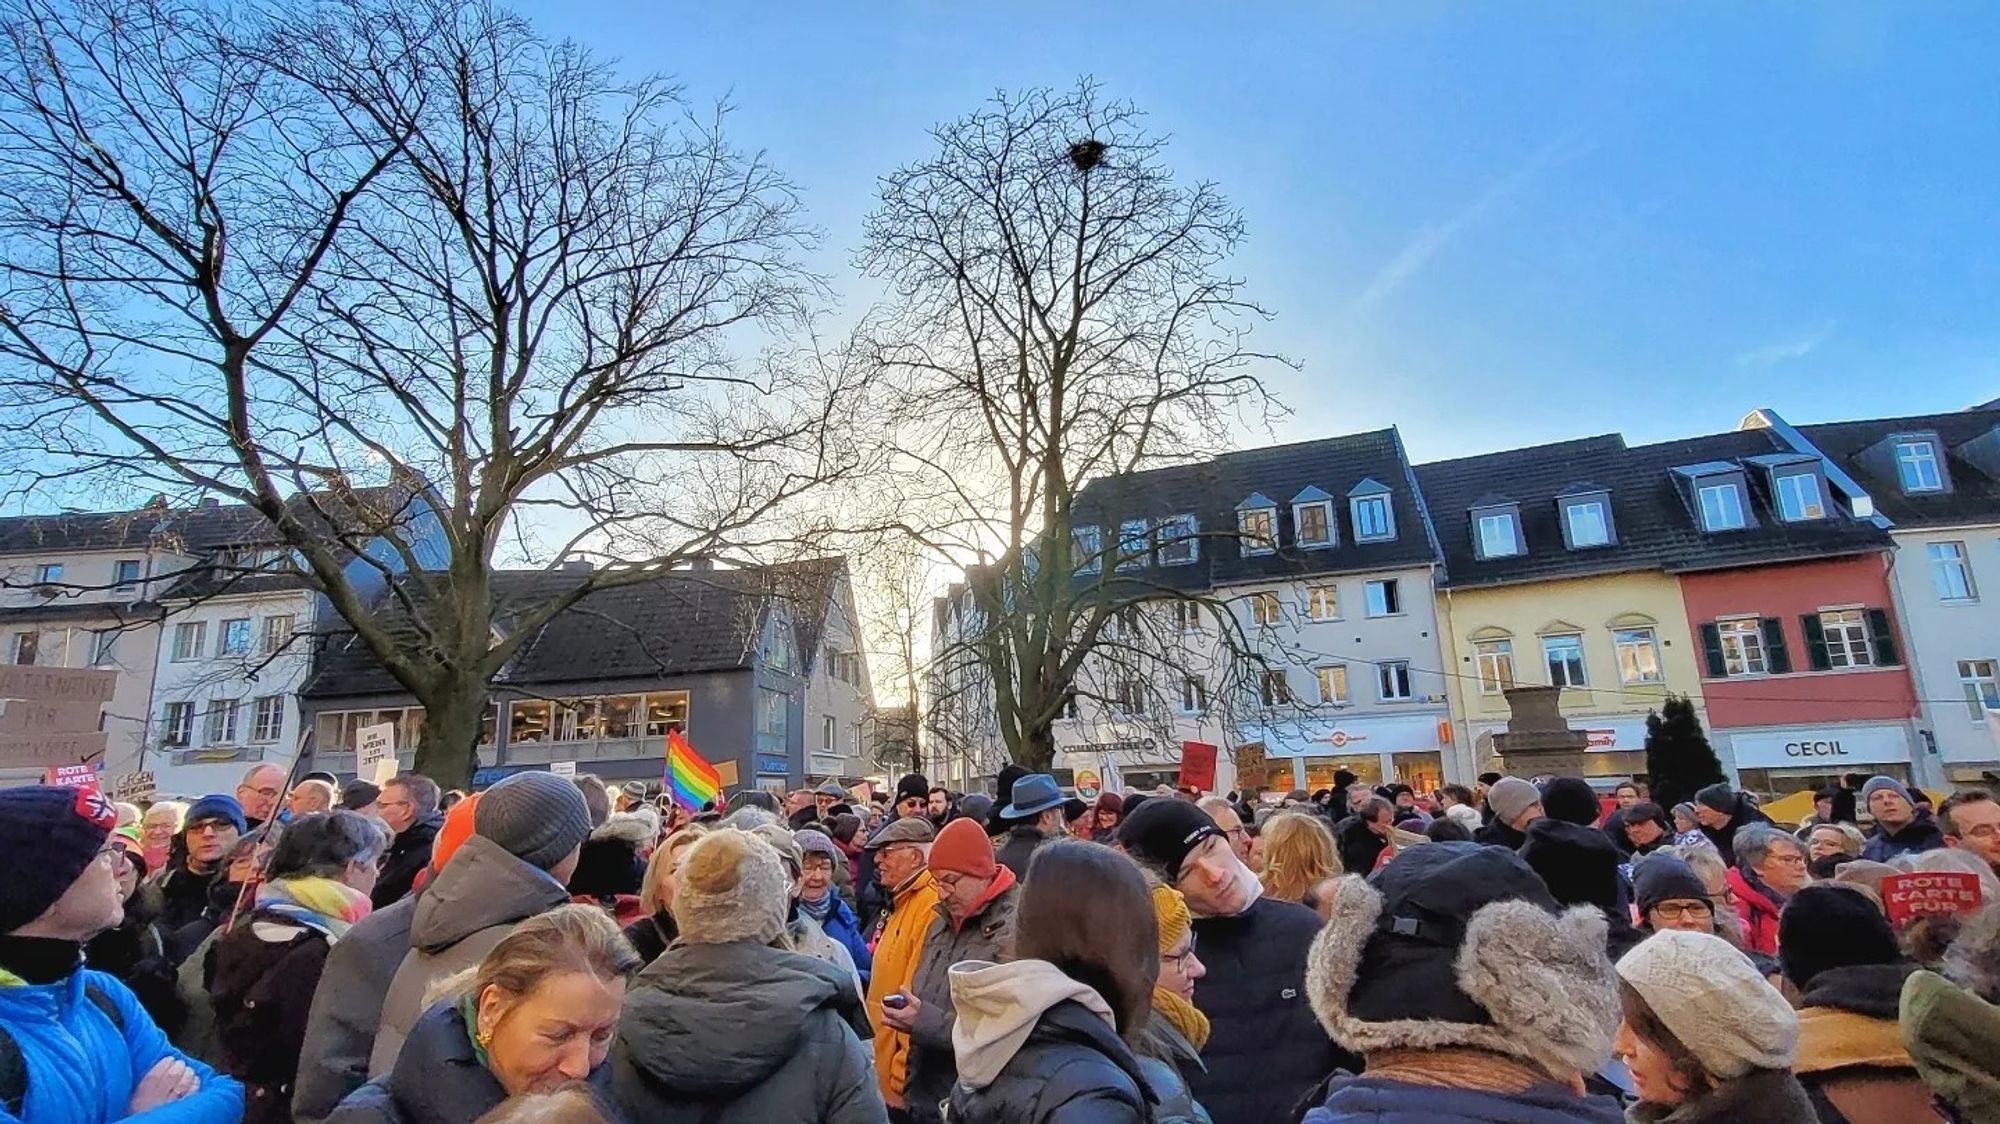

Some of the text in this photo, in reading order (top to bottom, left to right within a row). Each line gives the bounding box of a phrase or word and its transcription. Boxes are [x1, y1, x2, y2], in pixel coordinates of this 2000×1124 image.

[25, 705, 58, 726] FÜR
[1062, 741, 1140, 753] COMMERZBANK
[1586, 735, 1616, 749] amily
[1785, 741, 1848, 757] CECIL
[57, 765, 88, 776] ROTE
[56, 773, 95, 786] KARTE
[116, 771, 154, 789] GEGEN
[1897, 877, 1963, 889] ROTE
[1891, 889, 1975, 902] KARTE
[1909, 899, 1958, 912] FÜR
